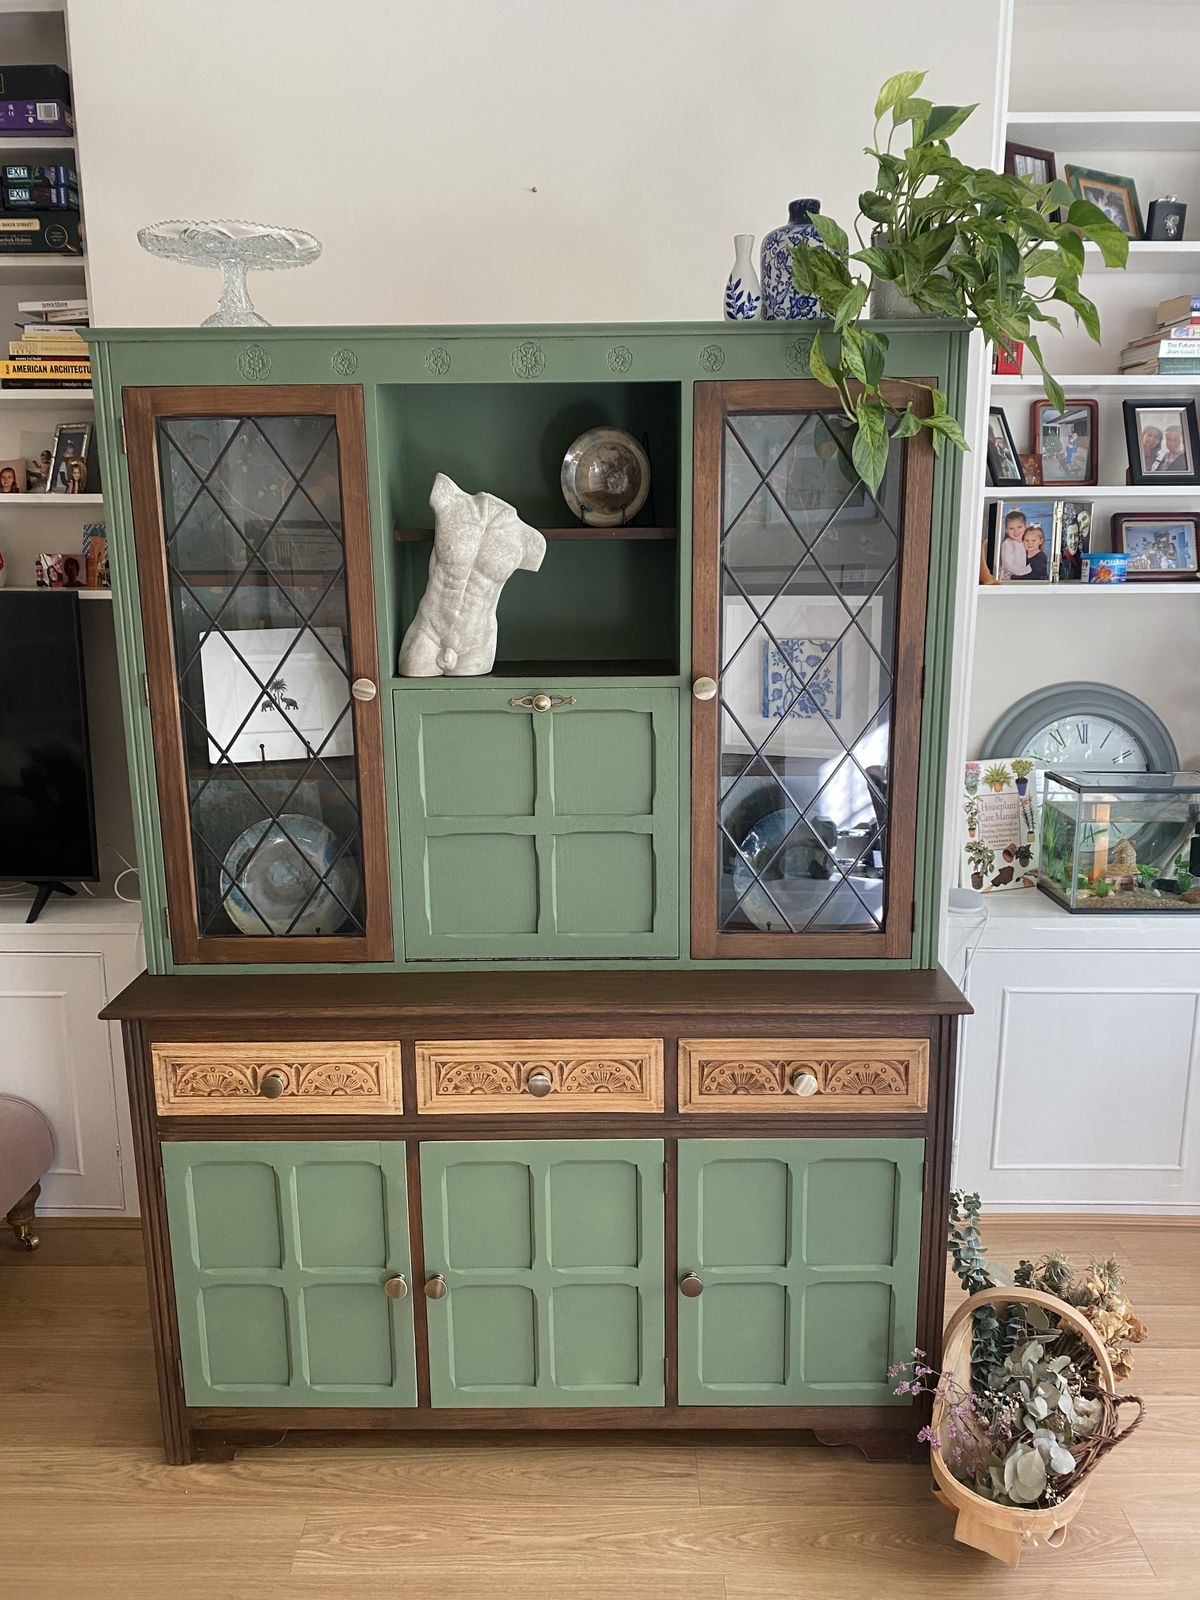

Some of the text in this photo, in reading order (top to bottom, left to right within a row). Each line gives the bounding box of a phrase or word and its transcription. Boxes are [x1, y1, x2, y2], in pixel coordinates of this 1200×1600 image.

[8, 167, 28, 177] EXIT
[10, 189, 29, 199] EXIT
[12, 364, 48, 374] AMERICAN
[981, 802, 1017, 813] Houseplant
[979, 811, 1019, 822] Care Manual
